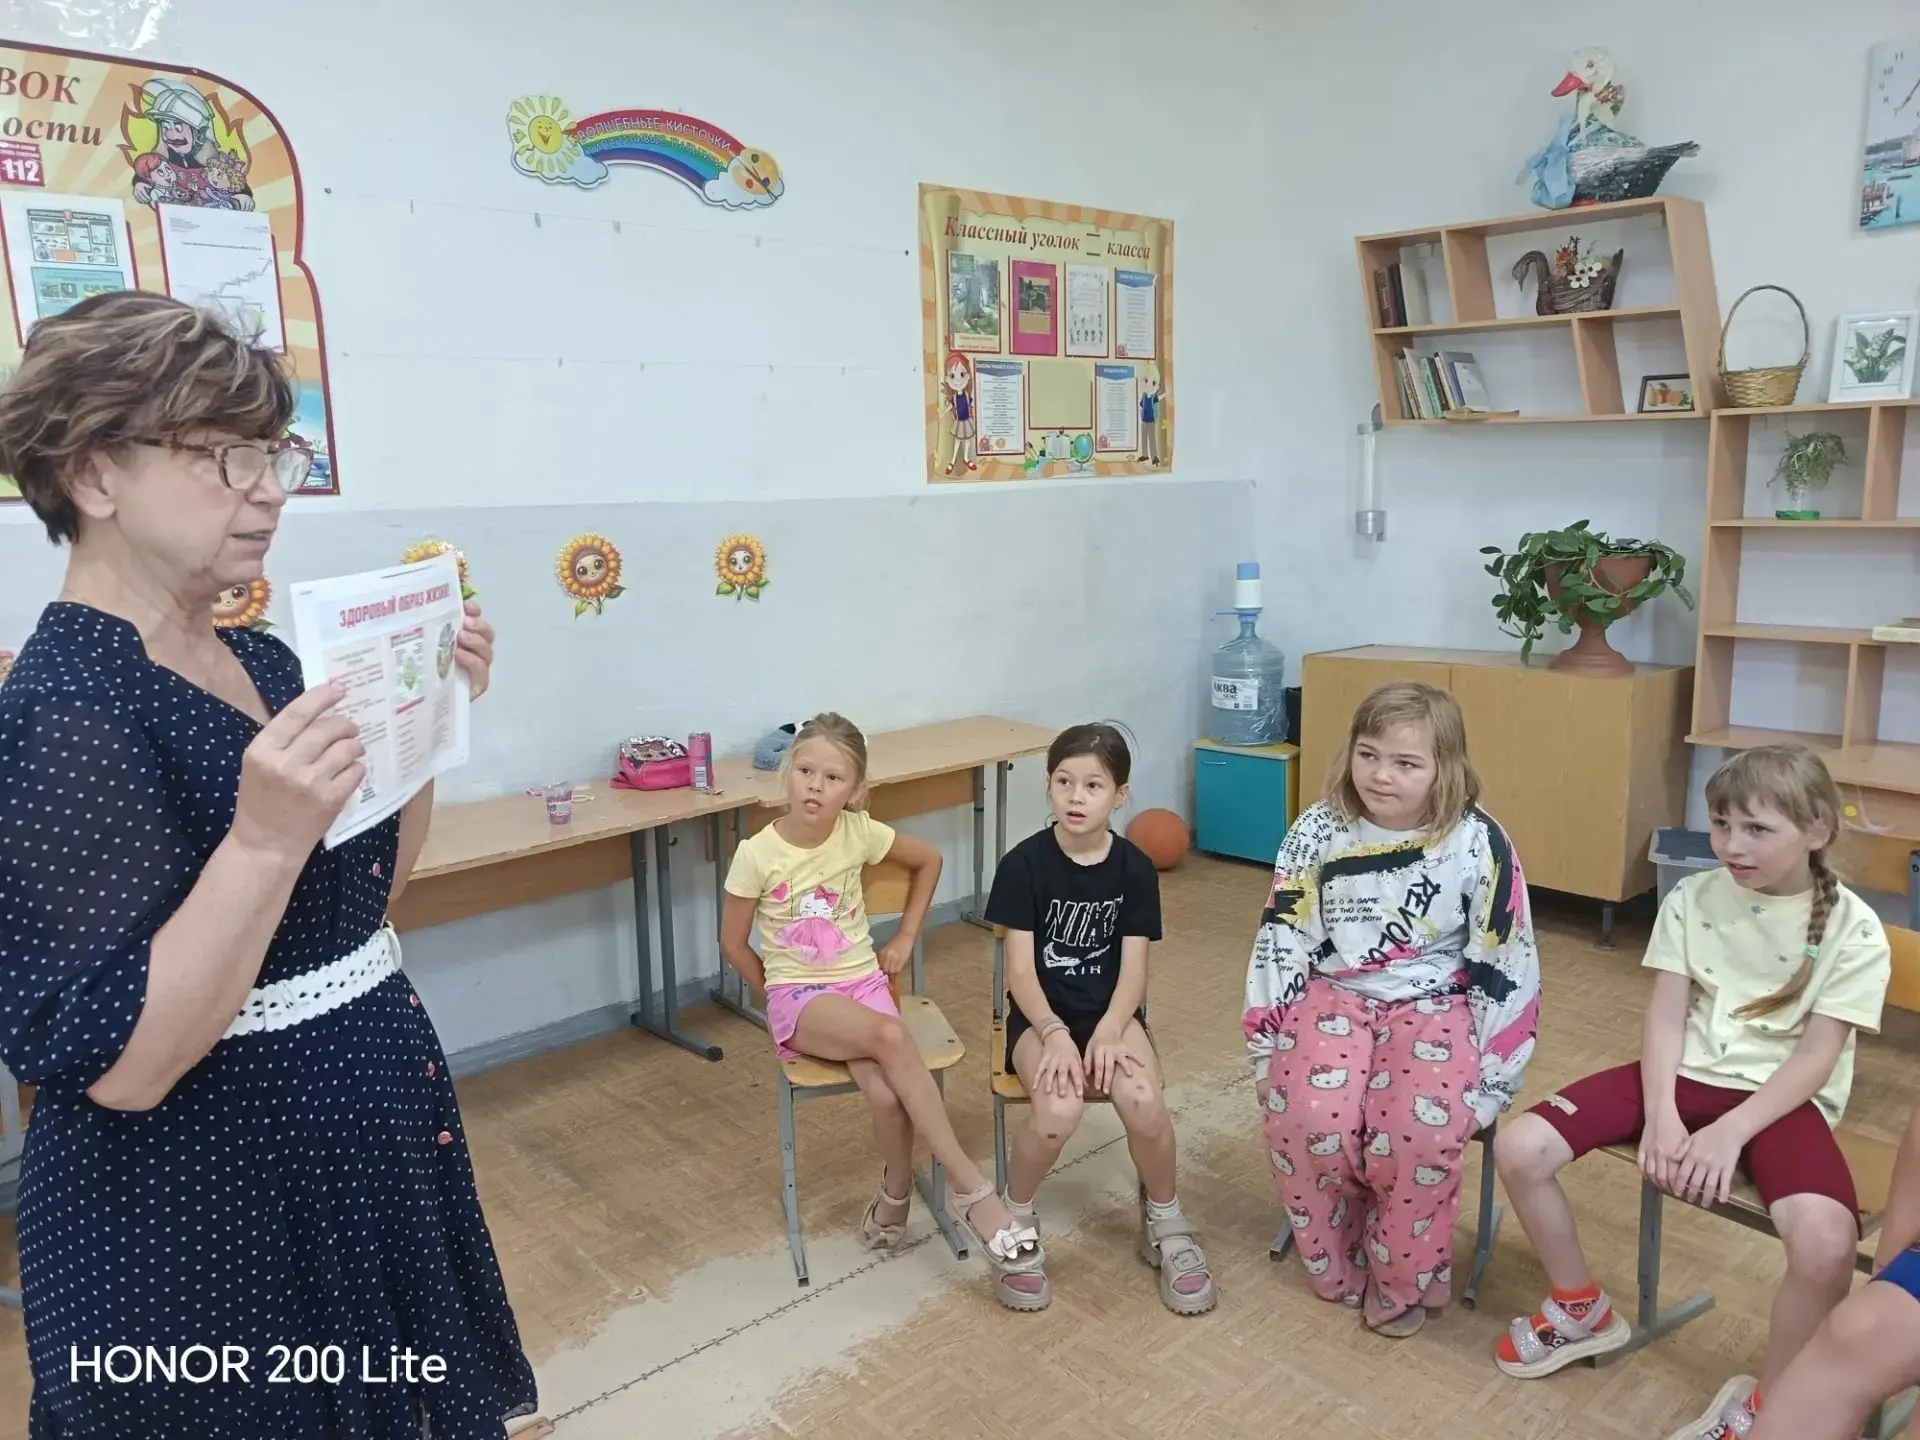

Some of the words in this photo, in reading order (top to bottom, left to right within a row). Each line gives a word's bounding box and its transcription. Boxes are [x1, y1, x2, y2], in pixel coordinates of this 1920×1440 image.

[577, 117, 661, 143] ВОЛШЕБНЫЕ
[666, 120, 732, 153] КИСТОЧКИ
[944, 216, 1027, 245] Классный
[1030, 232, 1081, 251] уголок
[1343, 915, 1359, 923] AND
[1064, 965, 1101, 976] AIR
